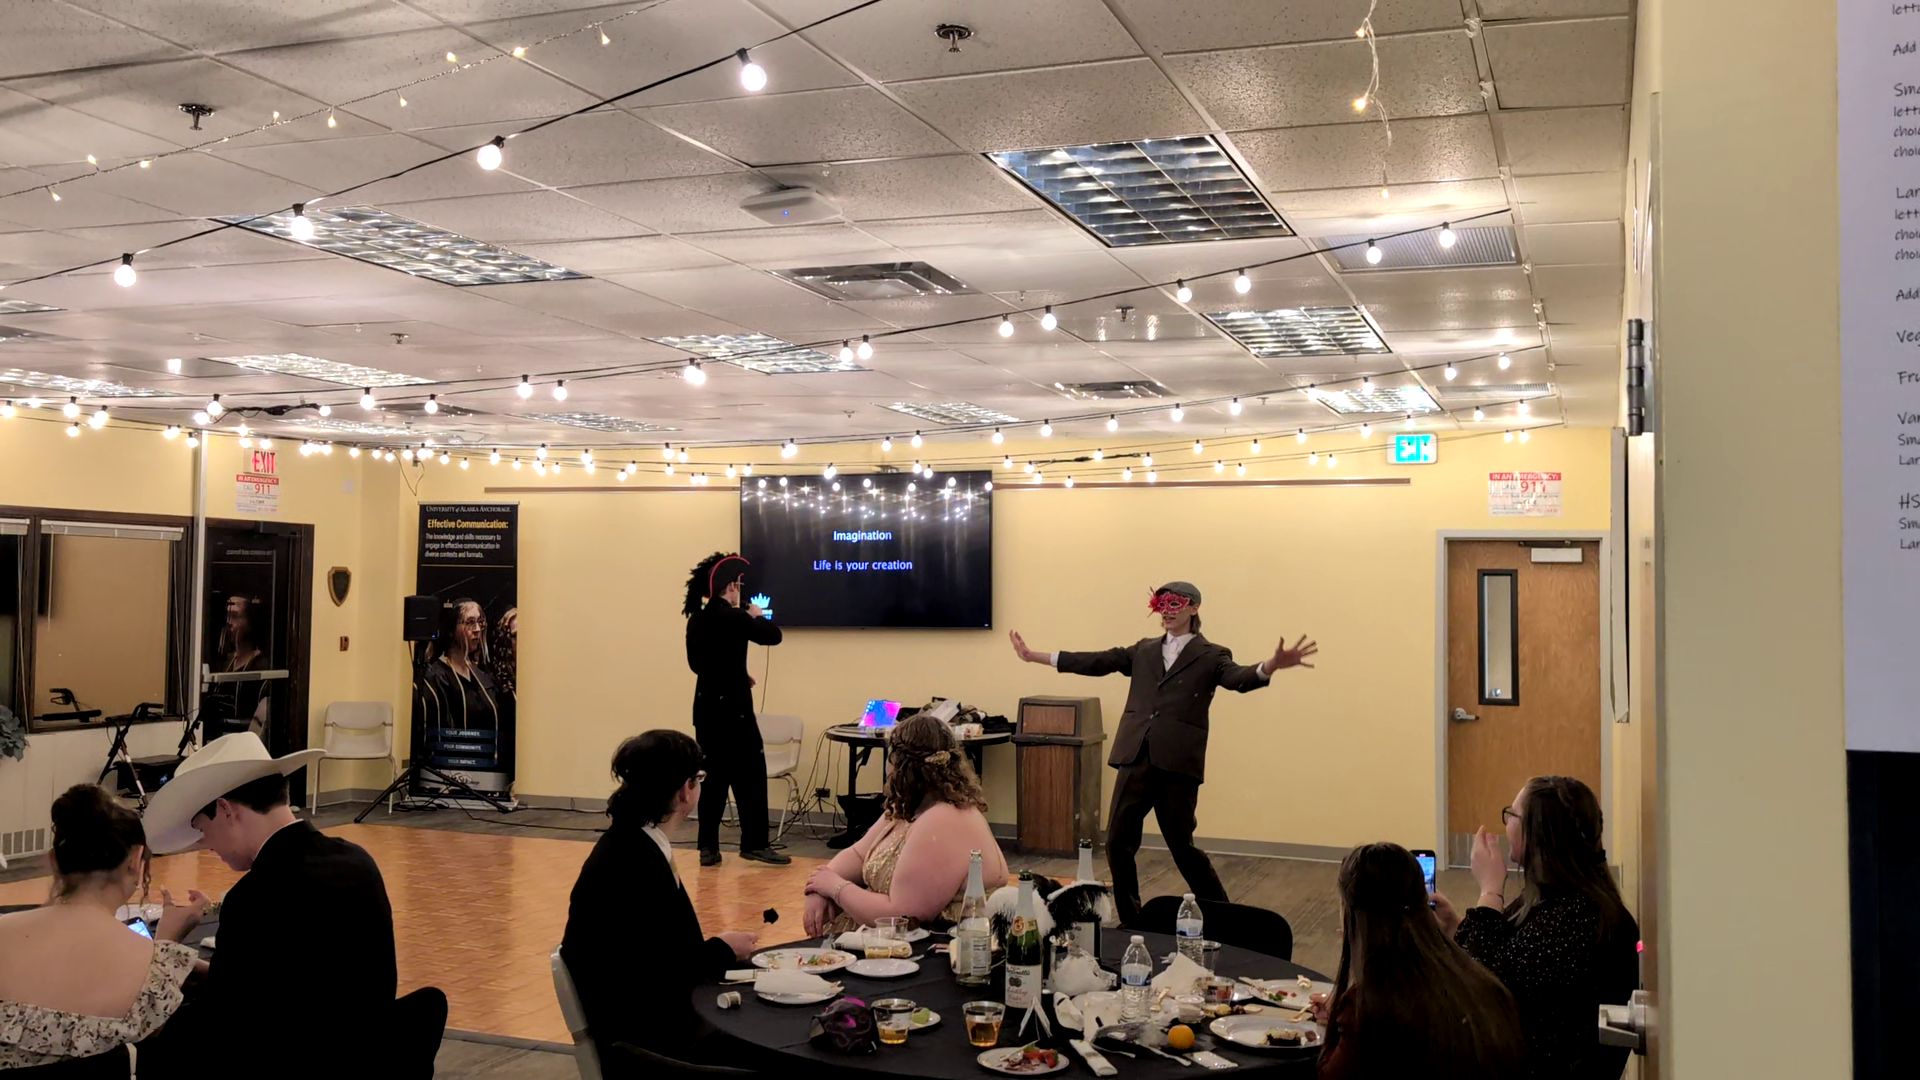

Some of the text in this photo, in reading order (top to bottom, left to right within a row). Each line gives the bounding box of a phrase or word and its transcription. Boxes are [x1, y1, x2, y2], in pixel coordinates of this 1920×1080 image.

[1893, 41, 1916, 56] Add
[1894, 106, 1920, 117] lett
[1895, 229, 1920, 241] choi
[1895, 249, 1920, 260] choi
[1896, 287, 1919, 301] Add
[253, 450, 276, 473] EXIT
[254, 484, 271, 495] 911
[1520, 481, 1546, 493] 911
[427, 519, 509, 529] Effective Communication:
[833, 530, 892, 543] Imagination
[813, 560, 913, 572] Life is your creation
